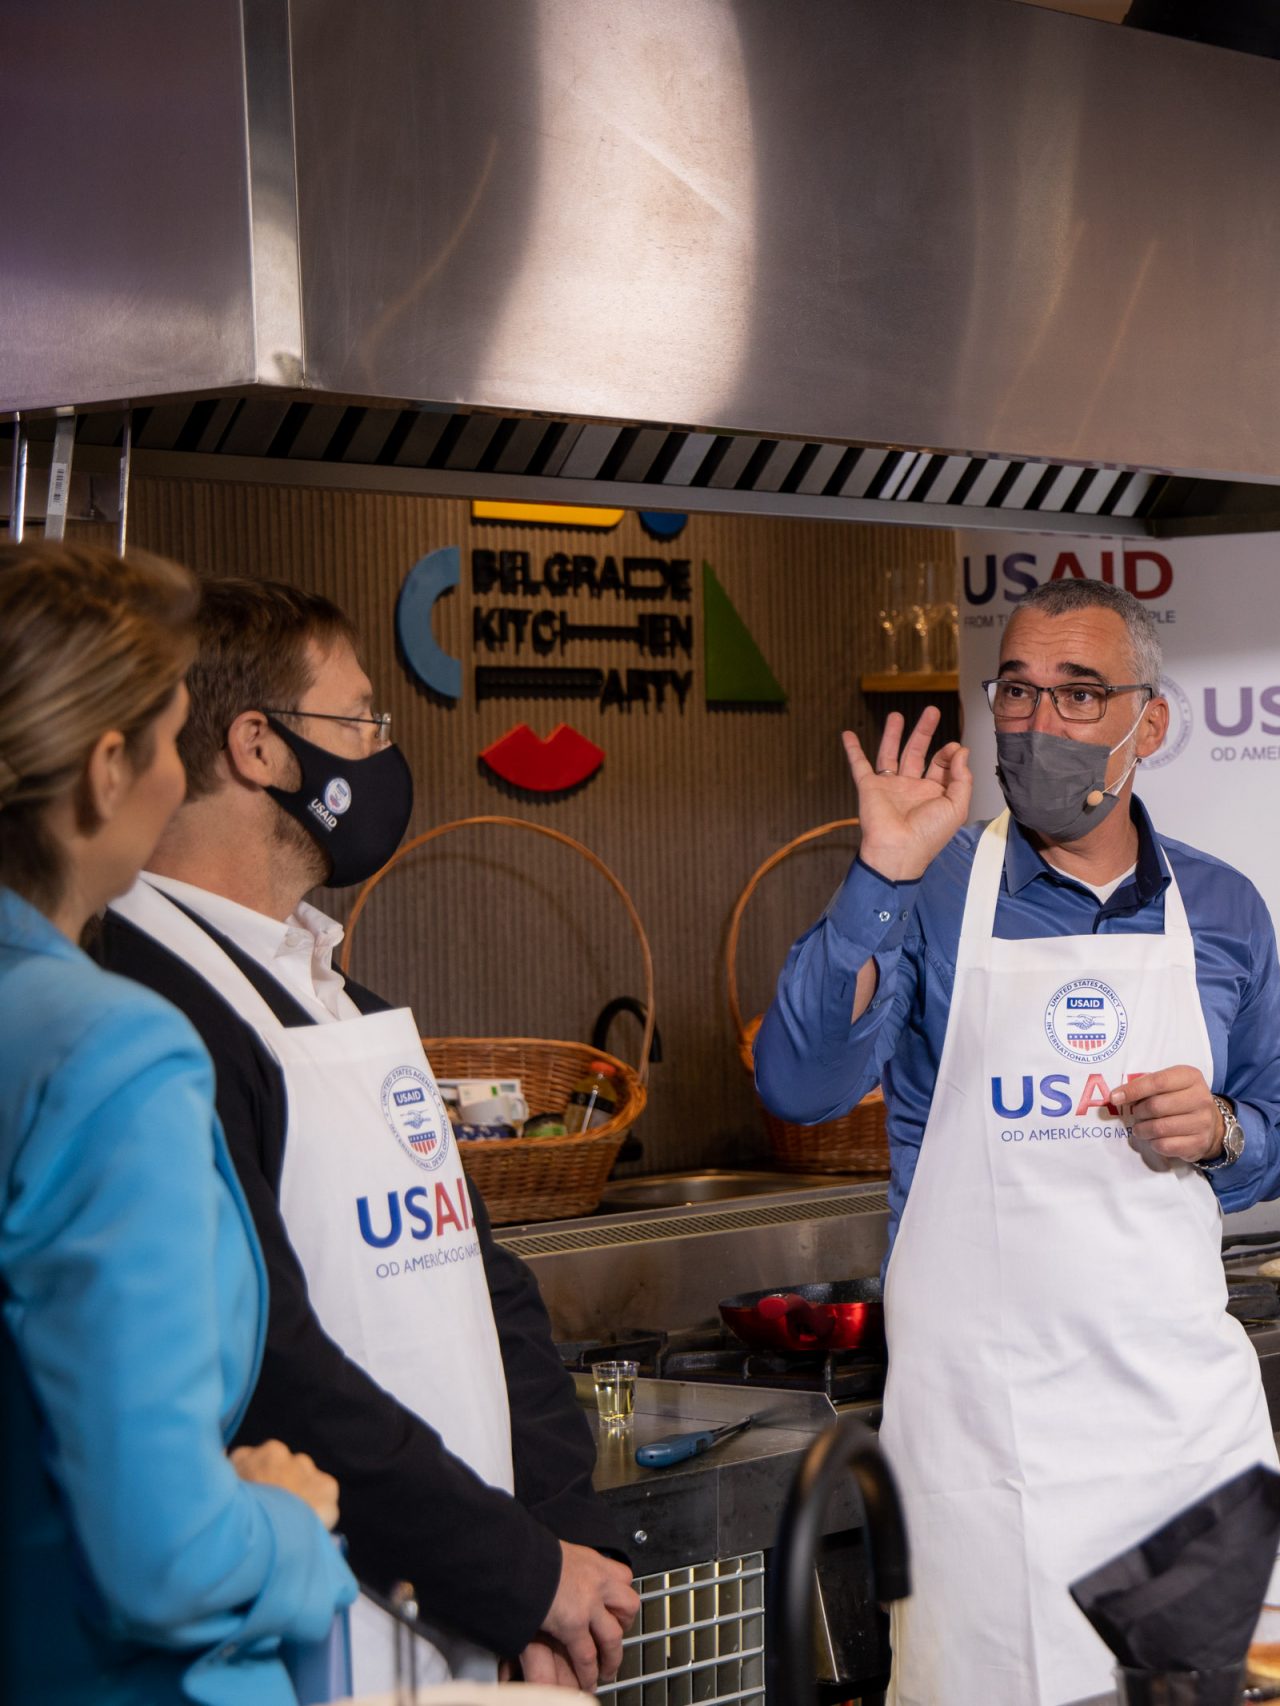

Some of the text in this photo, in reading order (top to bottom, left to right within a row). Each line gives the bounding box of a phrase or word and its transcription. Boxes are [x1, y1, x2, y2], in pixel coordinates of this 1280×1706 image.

[472, 549, 692, 602] BELGRADE
[474, 607, 692, 657] KITCHEN
[1211, 748, 1236, 761] OD
[311, 798, 337, 828] USAID
[1051, 986, 1072, 1007] UNITED
[1098, 984, 1121, 1007] AGENCY
[1047, 1021, 1125, 1062] INTERNATIONAL DEVELOPMENT
[392, 1069, 412, 1078] STATES
[397, 1091, 420, 1103] USAID
[991, 1073, 1153, 1119] USA
[1002, 1125, 1133, 1142] OD AMERIČKOG NAR
[356, 1178, 477, 1249] USAI
[376, 1261, 400, 1279] OD
[404, 1246, 465, 1273] AMERIČKOG
